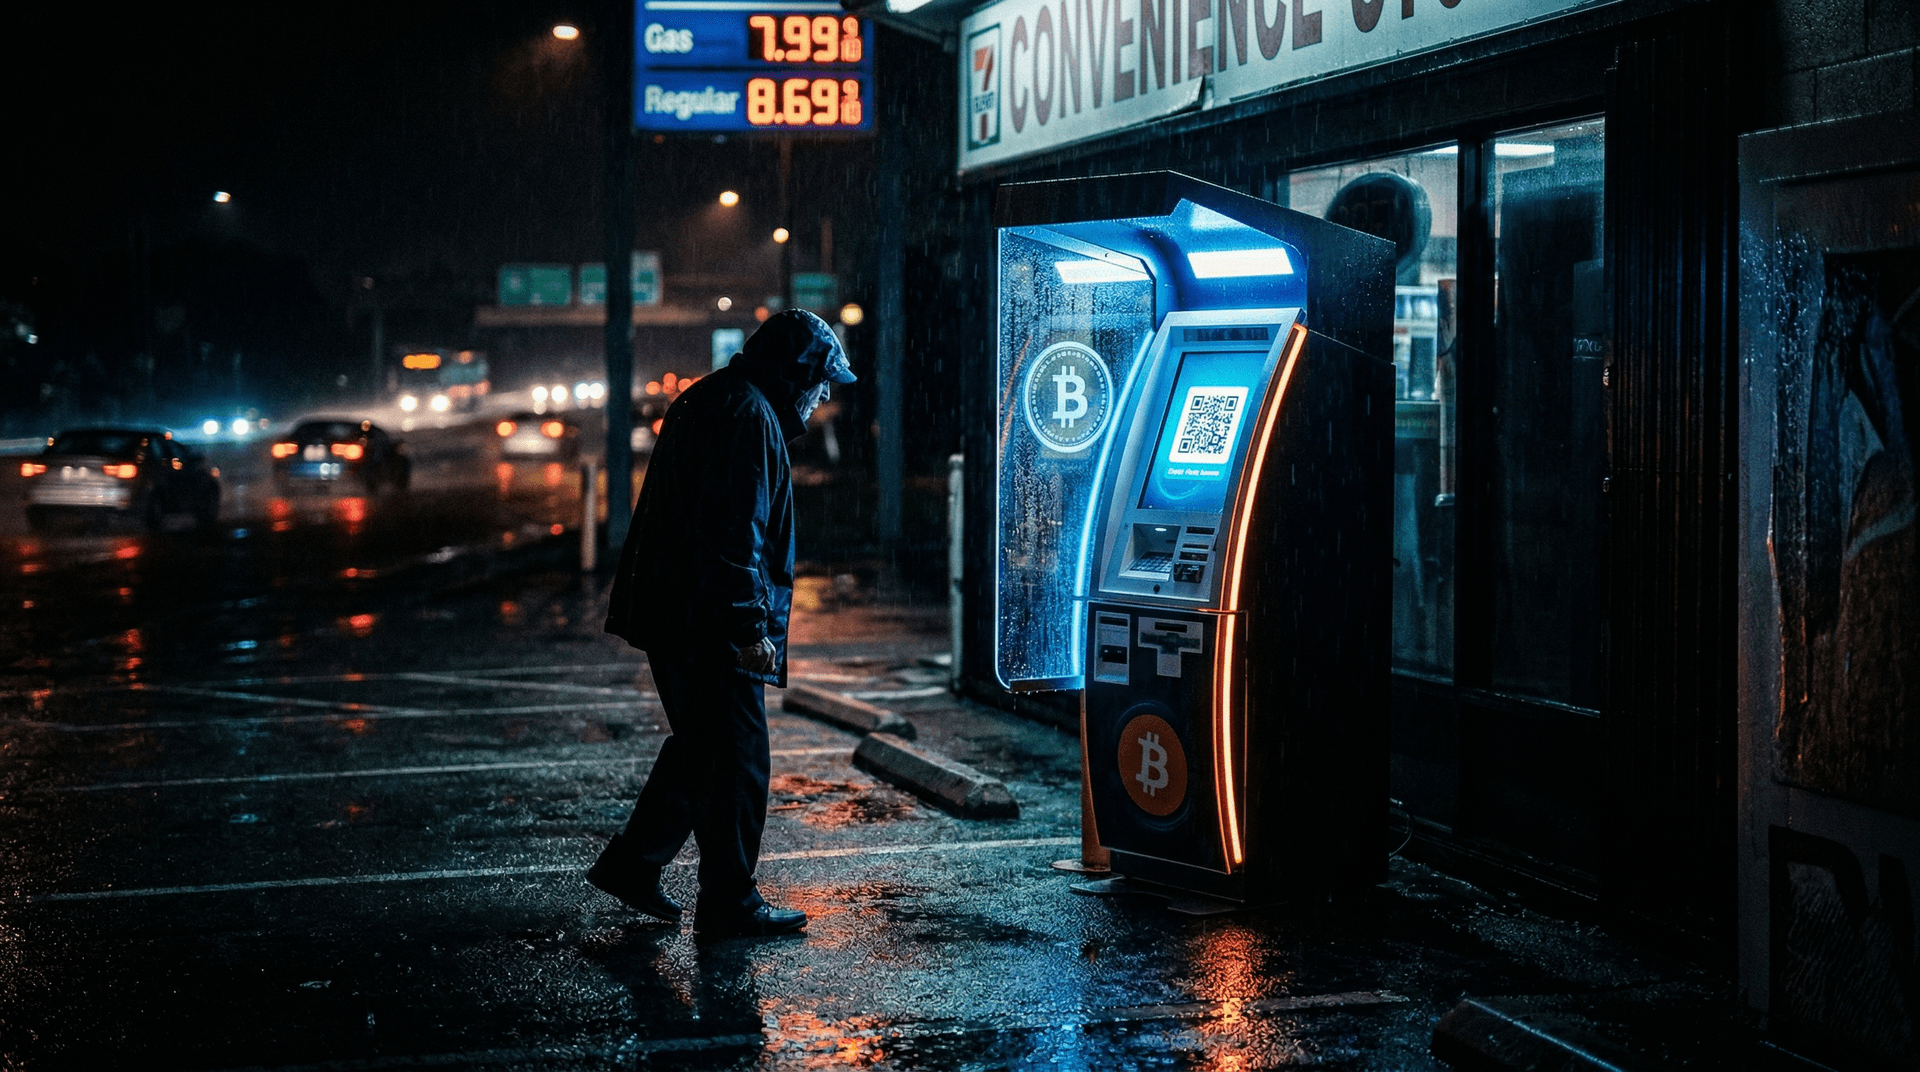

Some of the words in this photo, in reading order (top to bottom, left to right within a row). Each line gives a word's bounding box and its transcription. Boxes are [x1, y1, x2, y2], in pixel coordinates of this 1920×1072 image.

[645, 23, 694, 53] Gas
[749, 15, 839, 62] 7.99
[1010, 0, 1323, 134] CONVENIE
[645, 85, 740, 120] Regular
[748, 78, 839, 125] 8.69
